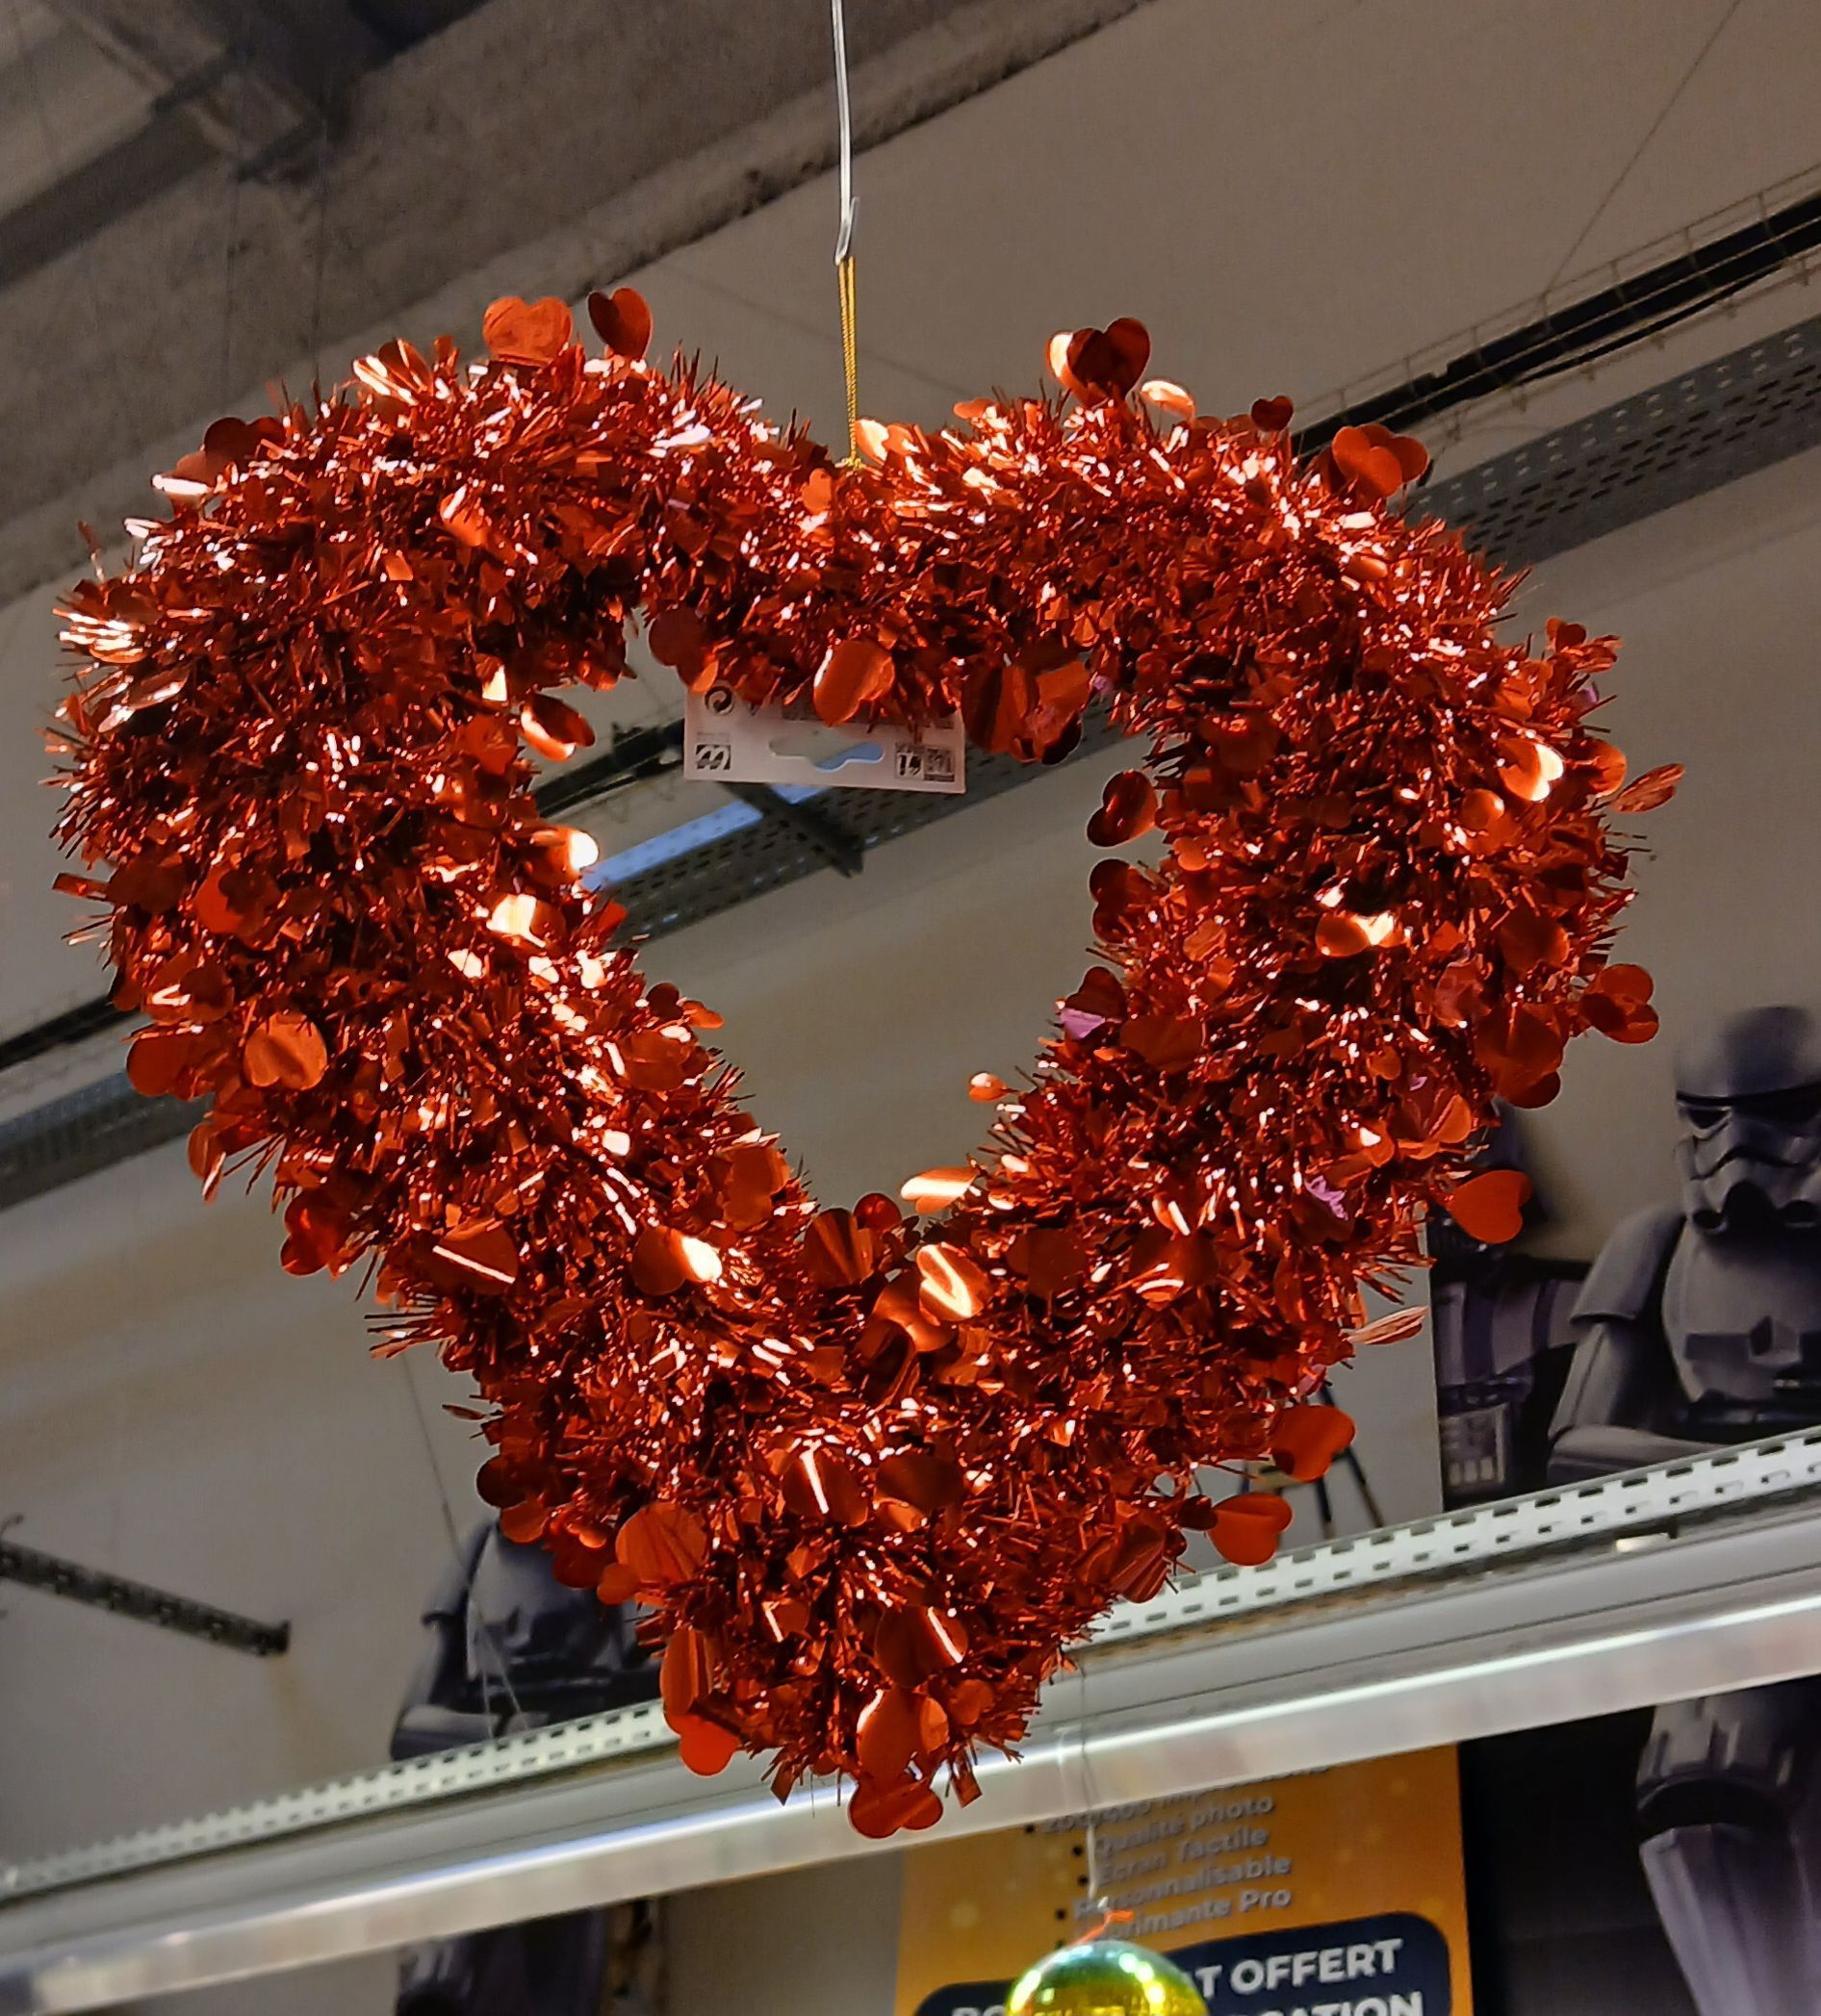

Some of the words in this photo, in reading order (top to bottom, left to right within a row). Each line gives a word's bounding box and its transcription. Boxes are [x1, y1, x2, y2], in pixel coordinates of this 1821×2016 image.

[1189, 1796, 1274, 1830] photo
[1239, 1888, 1292, 1912] Pro
[1230, 1937, 1404, 1996] OFFERT
